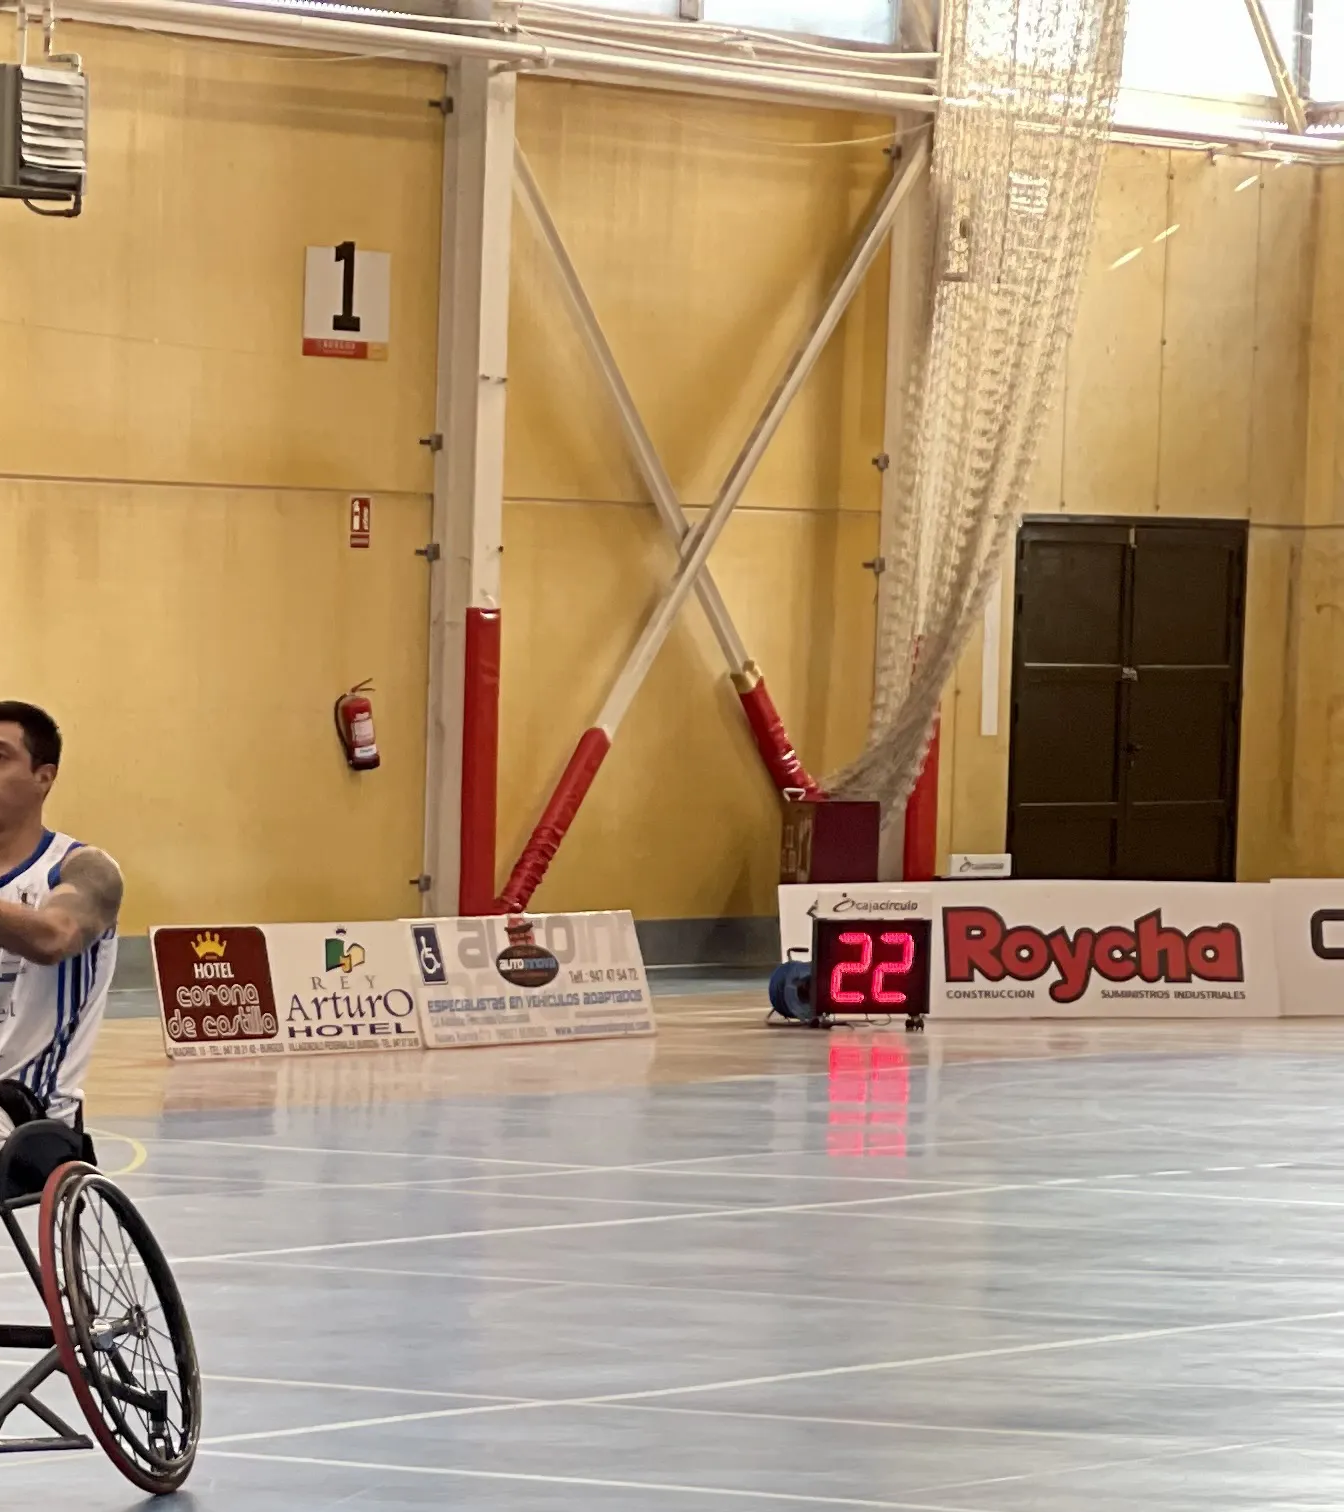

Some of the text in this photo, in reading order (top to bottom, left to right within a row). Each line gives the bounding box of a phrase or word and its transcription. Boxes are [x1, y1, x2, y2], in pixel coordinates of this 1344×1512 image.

[333, 241, 360, 332] 1
[942, 906, 1244, 1004] Roycha
[193, 962, 235, 979] HOTEL
[831, 932, 914, 1003] 22
[176, 983, 260, 1007] corona
[311, 975, 377, 991] REY
[1173, 989, 1246, 1000] INDUSTRIALES
[167, 1008, 197, 1039] de
[288, 1022, 416, 1038] HOTEL
